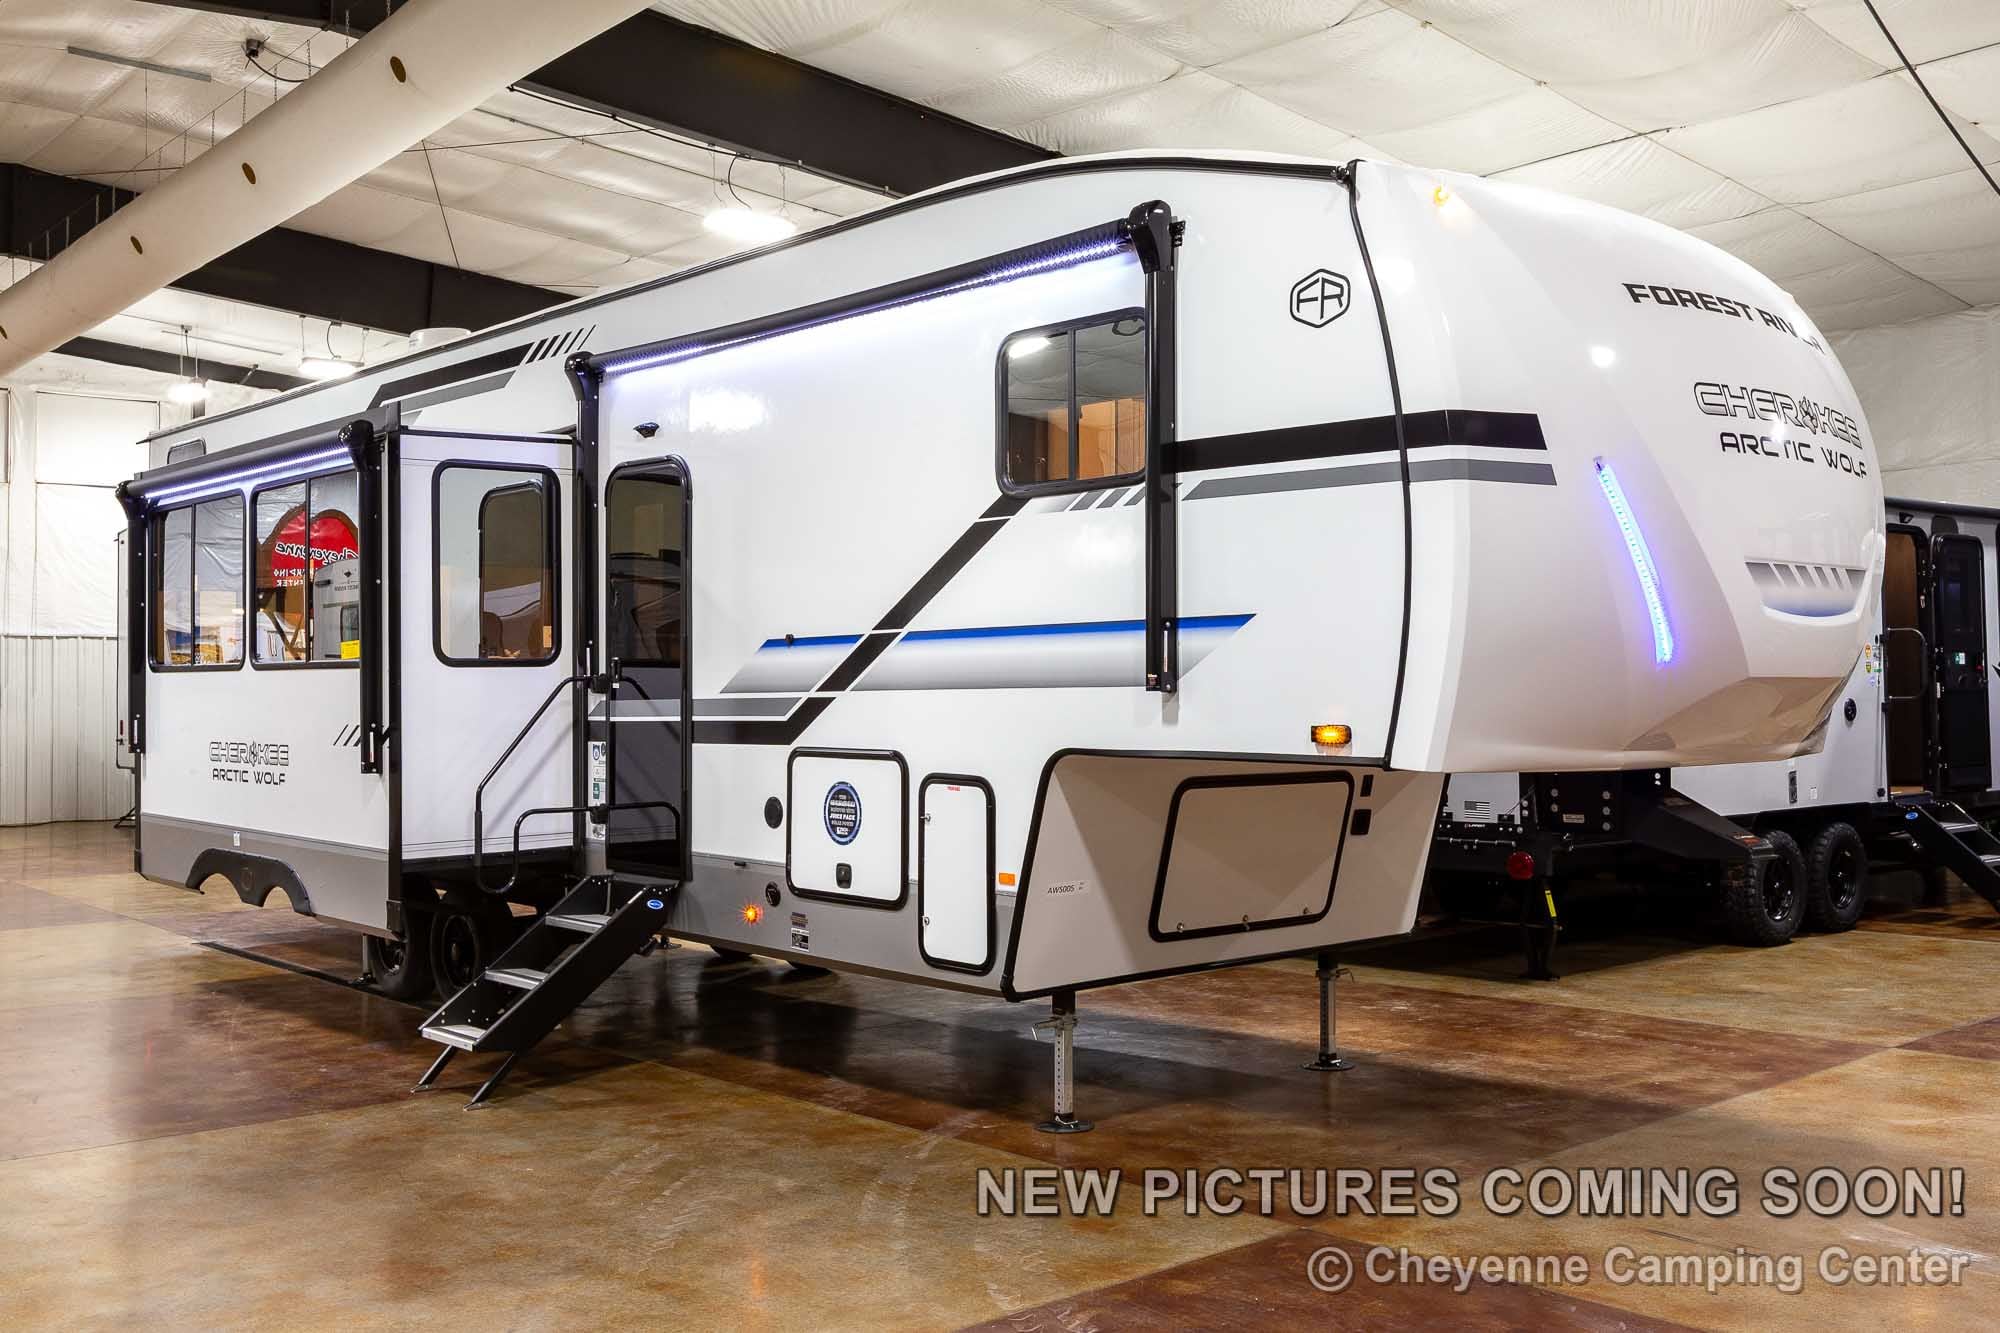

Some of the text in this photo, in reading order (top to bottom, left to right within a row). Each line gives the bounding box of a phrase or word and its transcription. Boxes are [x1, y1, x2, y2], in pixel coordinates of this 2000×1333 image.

[1622, 283, 1754, 321] FOREST
[1694, 382, 1863, 449] CHEROKEE
[1720, 432, 1867, 478] ARCTIC WOLF
[209, 741, 289, 767] CHEROKEE
[212, 768, 286, 786] ARCTIC WOLF
